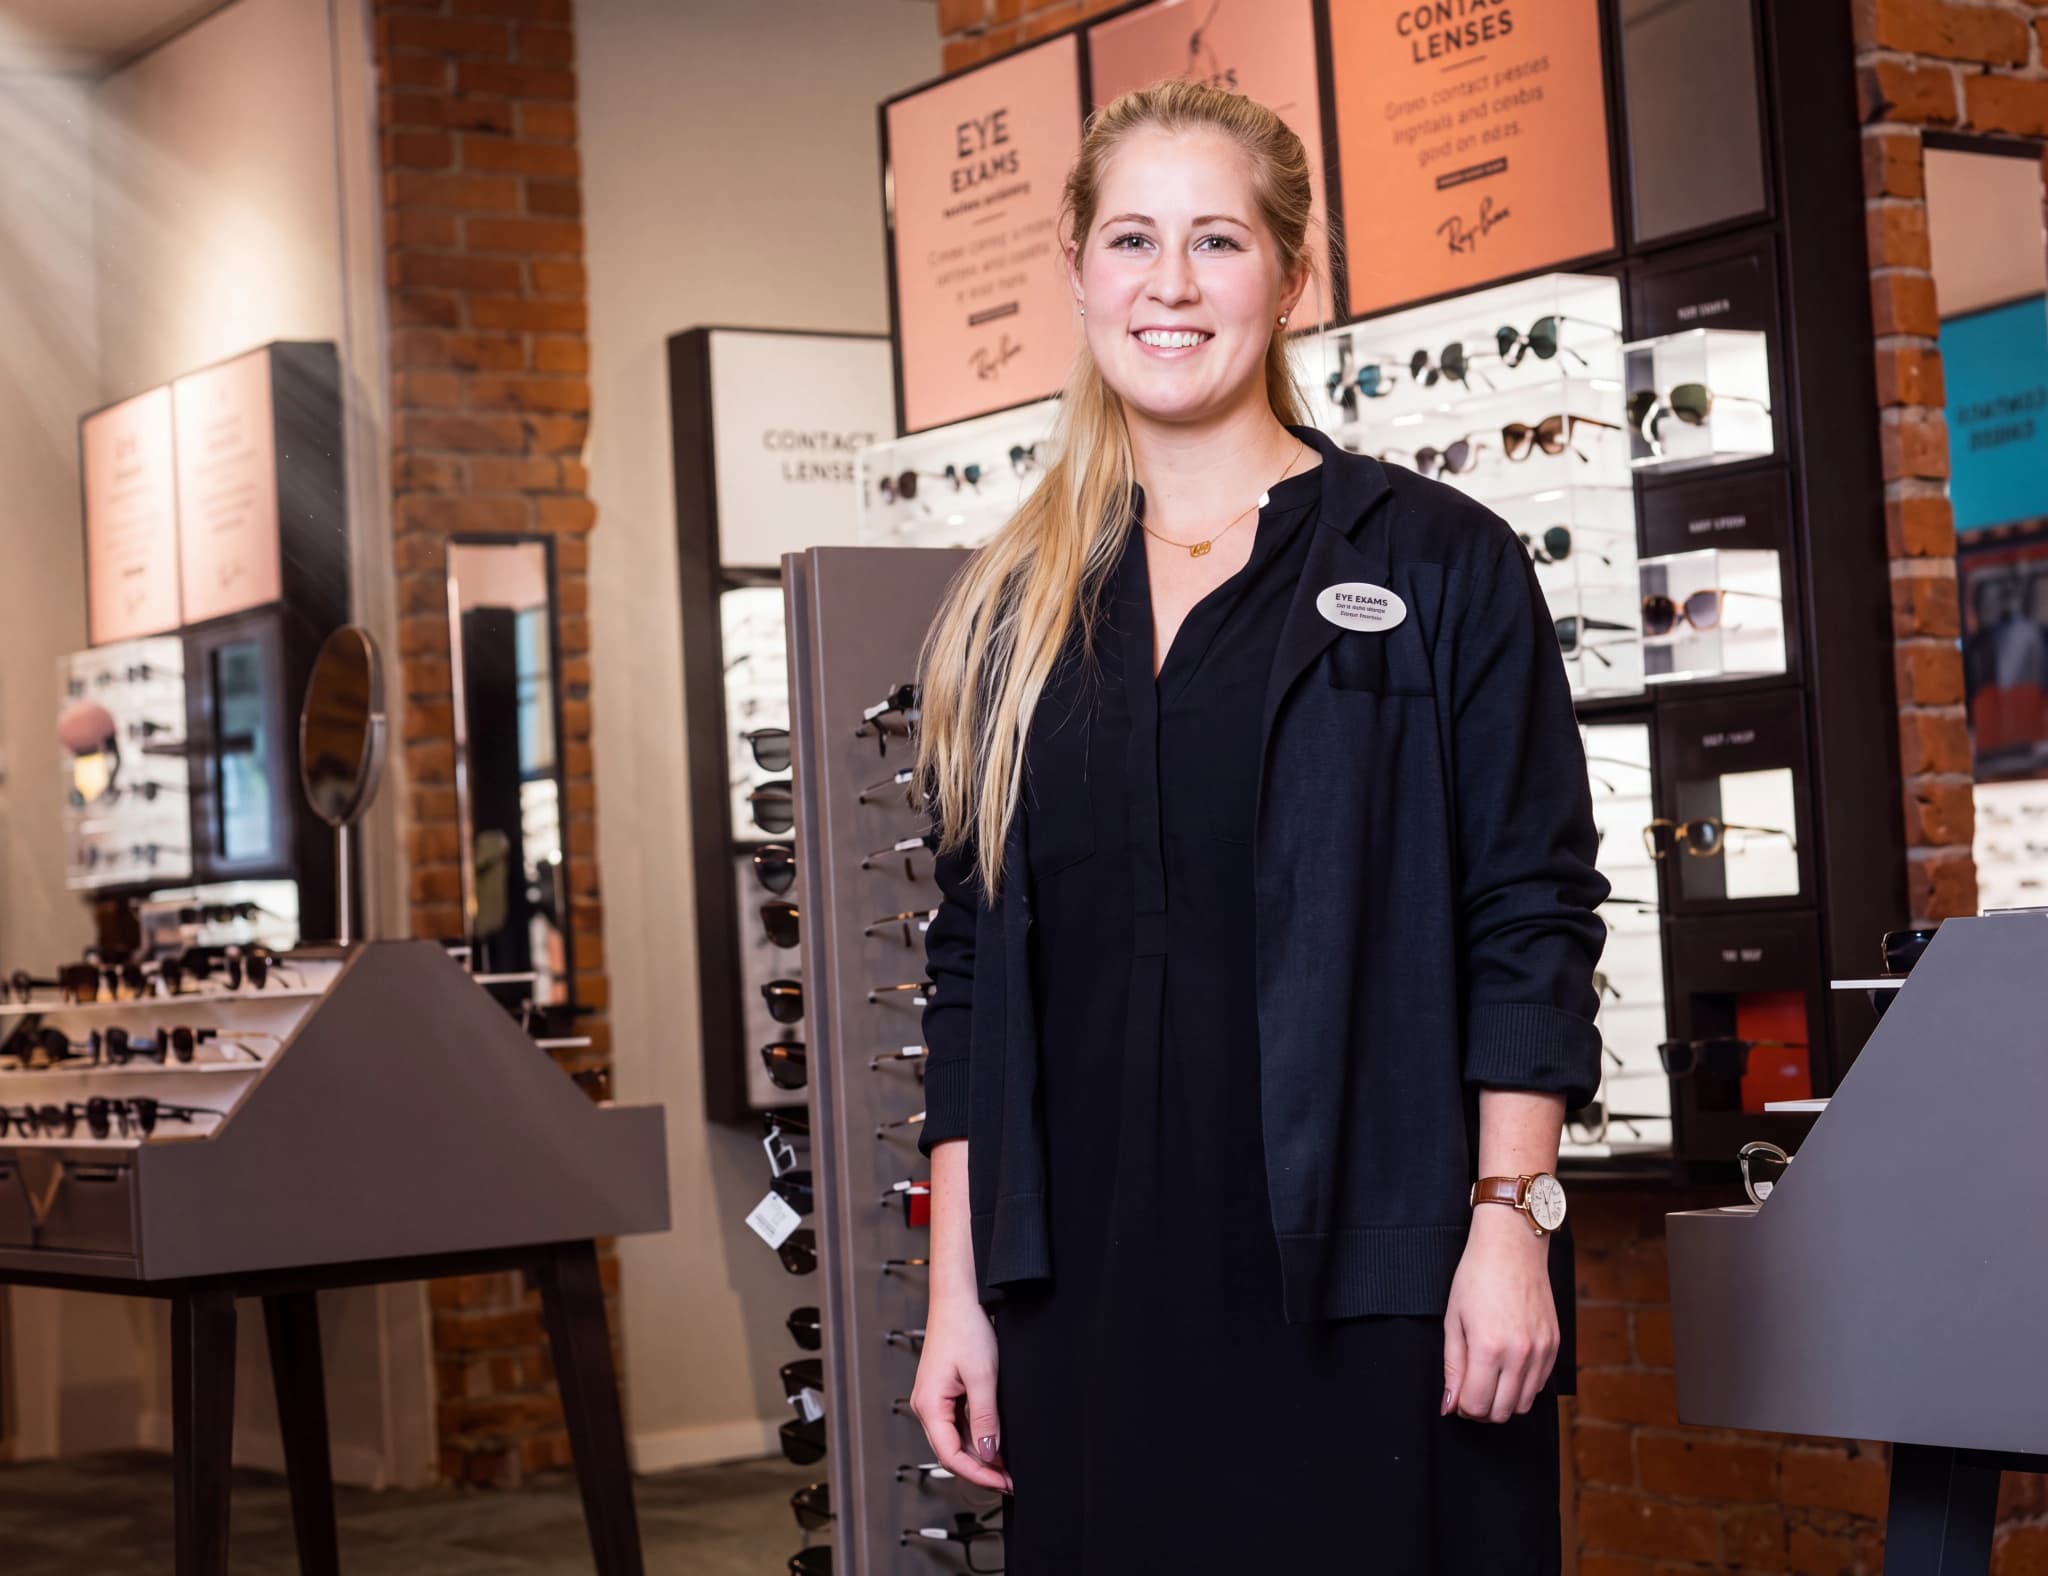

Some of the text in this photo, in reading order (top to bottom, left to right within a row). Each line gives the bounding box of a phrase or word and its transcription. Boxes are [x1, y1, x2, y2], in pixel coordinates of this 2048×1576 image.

[1396, 0, 1505, 36] CONT
[1412, 9, 1513, 64] LENSES
[957, 108, 1009, 158] EYE
[951, 150, 1020, 195] EXAMS
[763, 431, 876, 451] CONTACT
[1335, 593, 1388, 607] EYE EXAMS
